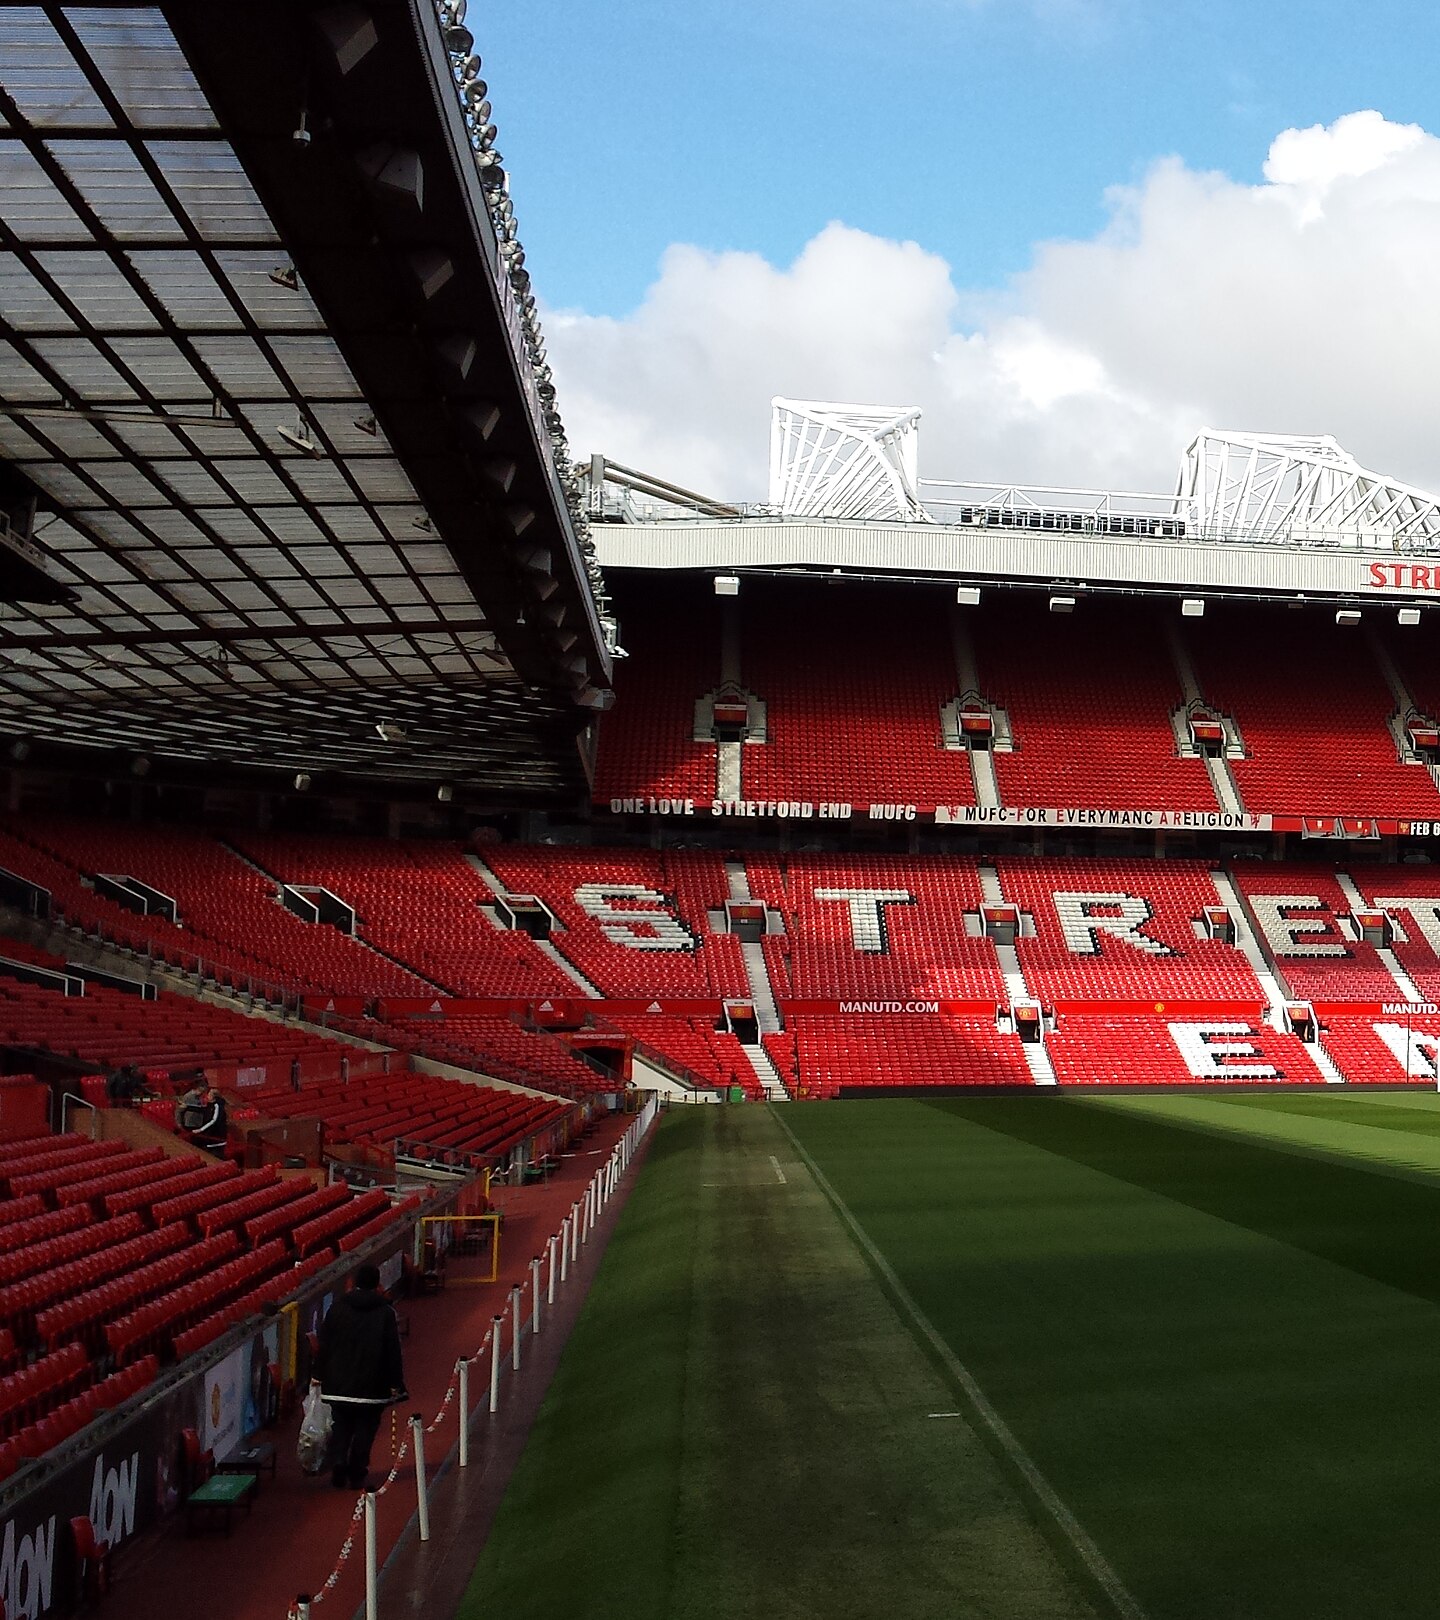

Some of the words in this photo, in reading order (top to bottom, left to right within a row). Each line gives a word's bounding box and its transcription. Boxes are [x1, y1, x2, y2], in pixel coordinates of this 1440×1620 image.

[610, 798, 645, 814] ONE
[649, 797, 694, 815] LOVE
[711, 799, 813, 818] STRETFORD
[818, 801, 851, 819] END
[869, 804, 917, 820] MUFC
[1159, 811, 1168, 825] A
[1172, 811, 1245, 828] RELIGION
[1410, 821, 1430, 836] FEB
[839, 1001, 939, 1014] MANUTD.COM
[88, 1451, 139, 1550] AON
